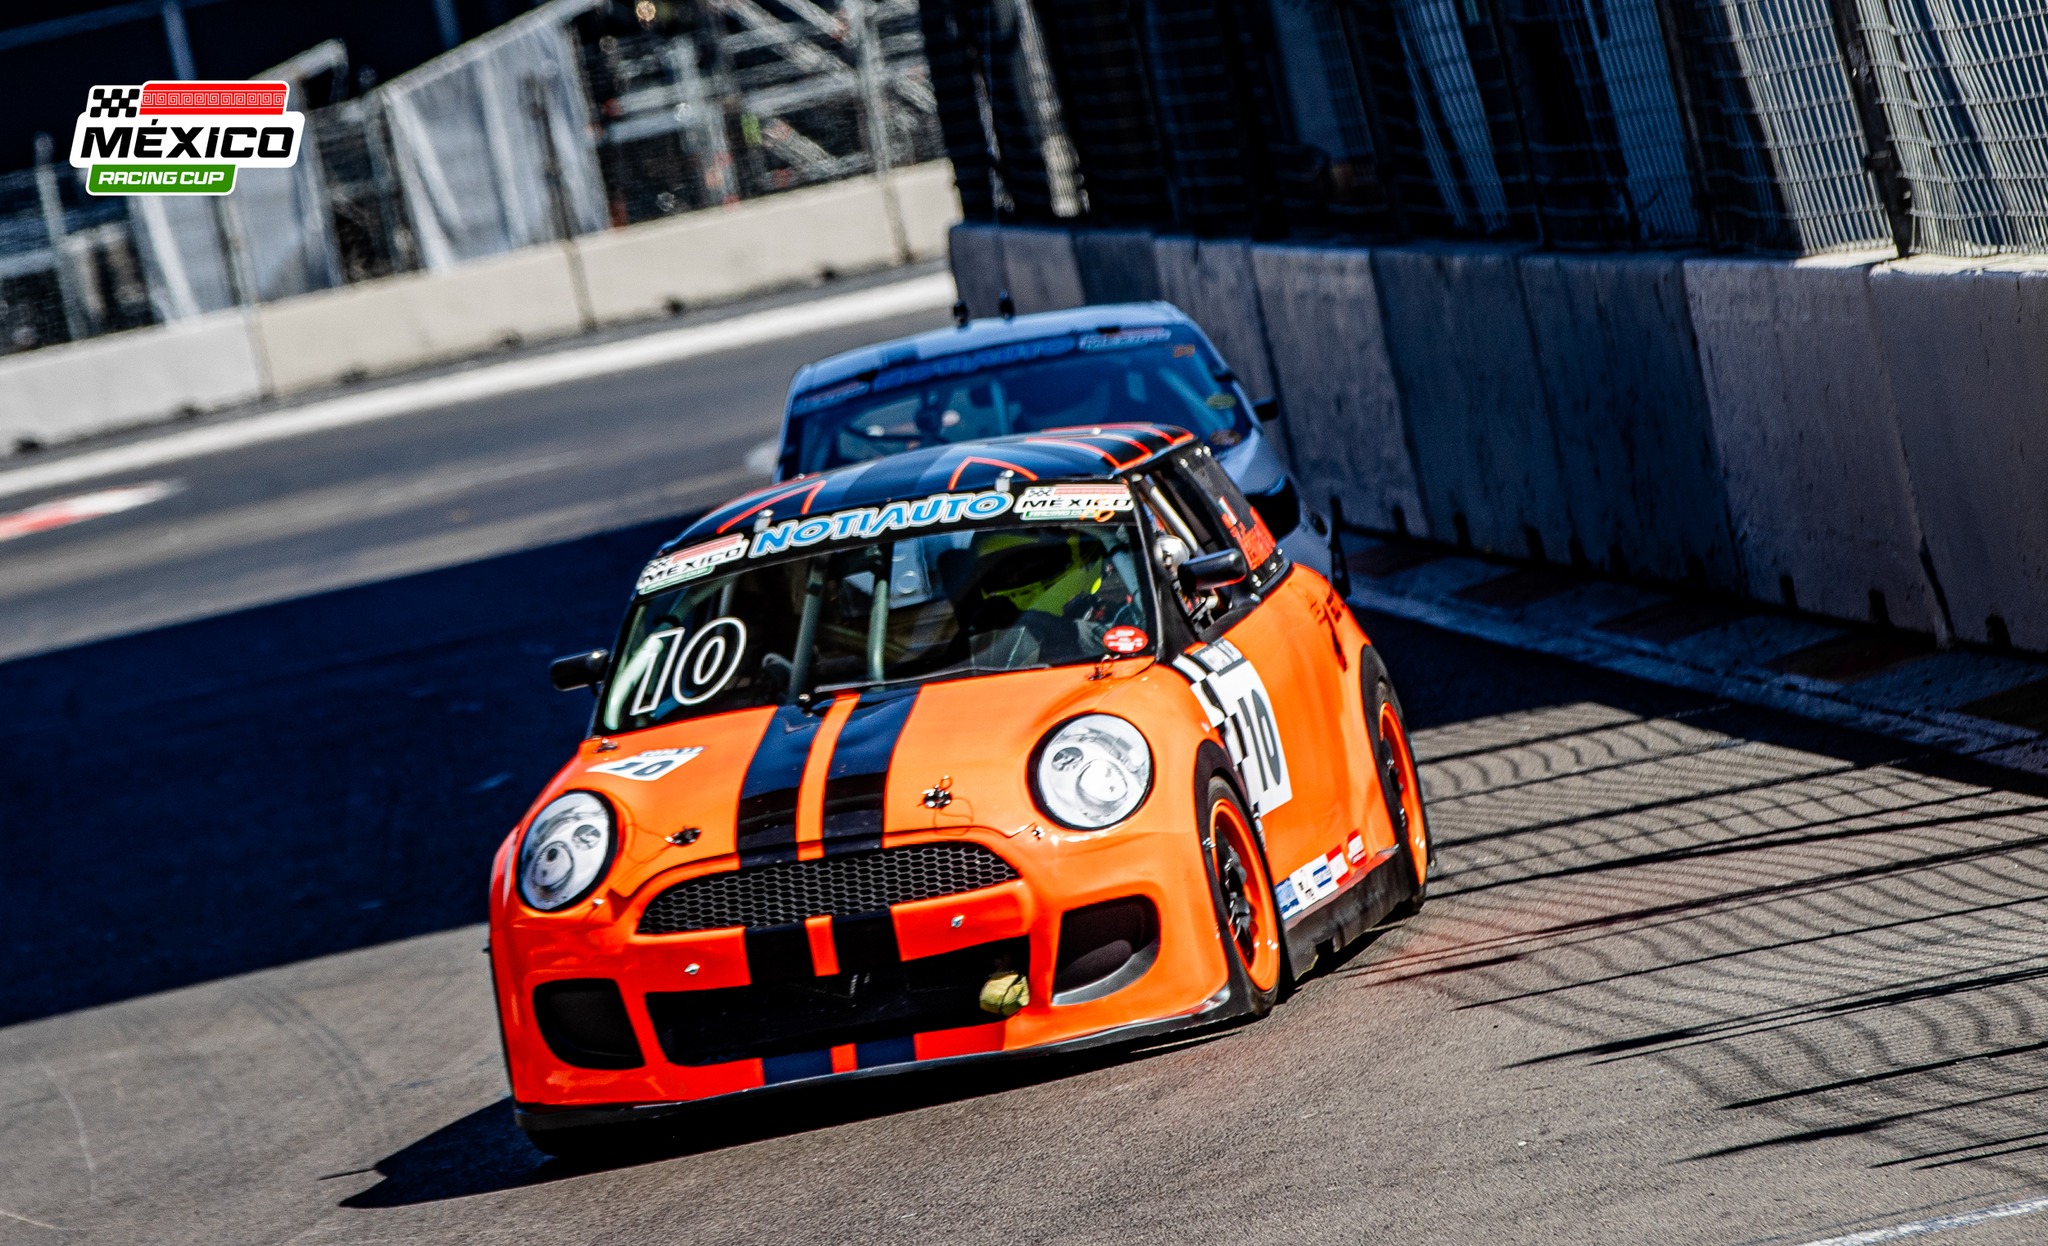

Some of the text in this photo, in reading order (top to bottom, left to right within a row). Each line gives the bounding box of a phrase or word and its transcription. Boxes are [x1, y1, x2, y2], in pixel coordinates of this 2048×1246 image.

[749, 491, 1013, 558] NOTIAUTO
[629, 616, 747, 716] 10
[608, 759, 674, 777] 10
[1237, 688, 1281, 793] 10
